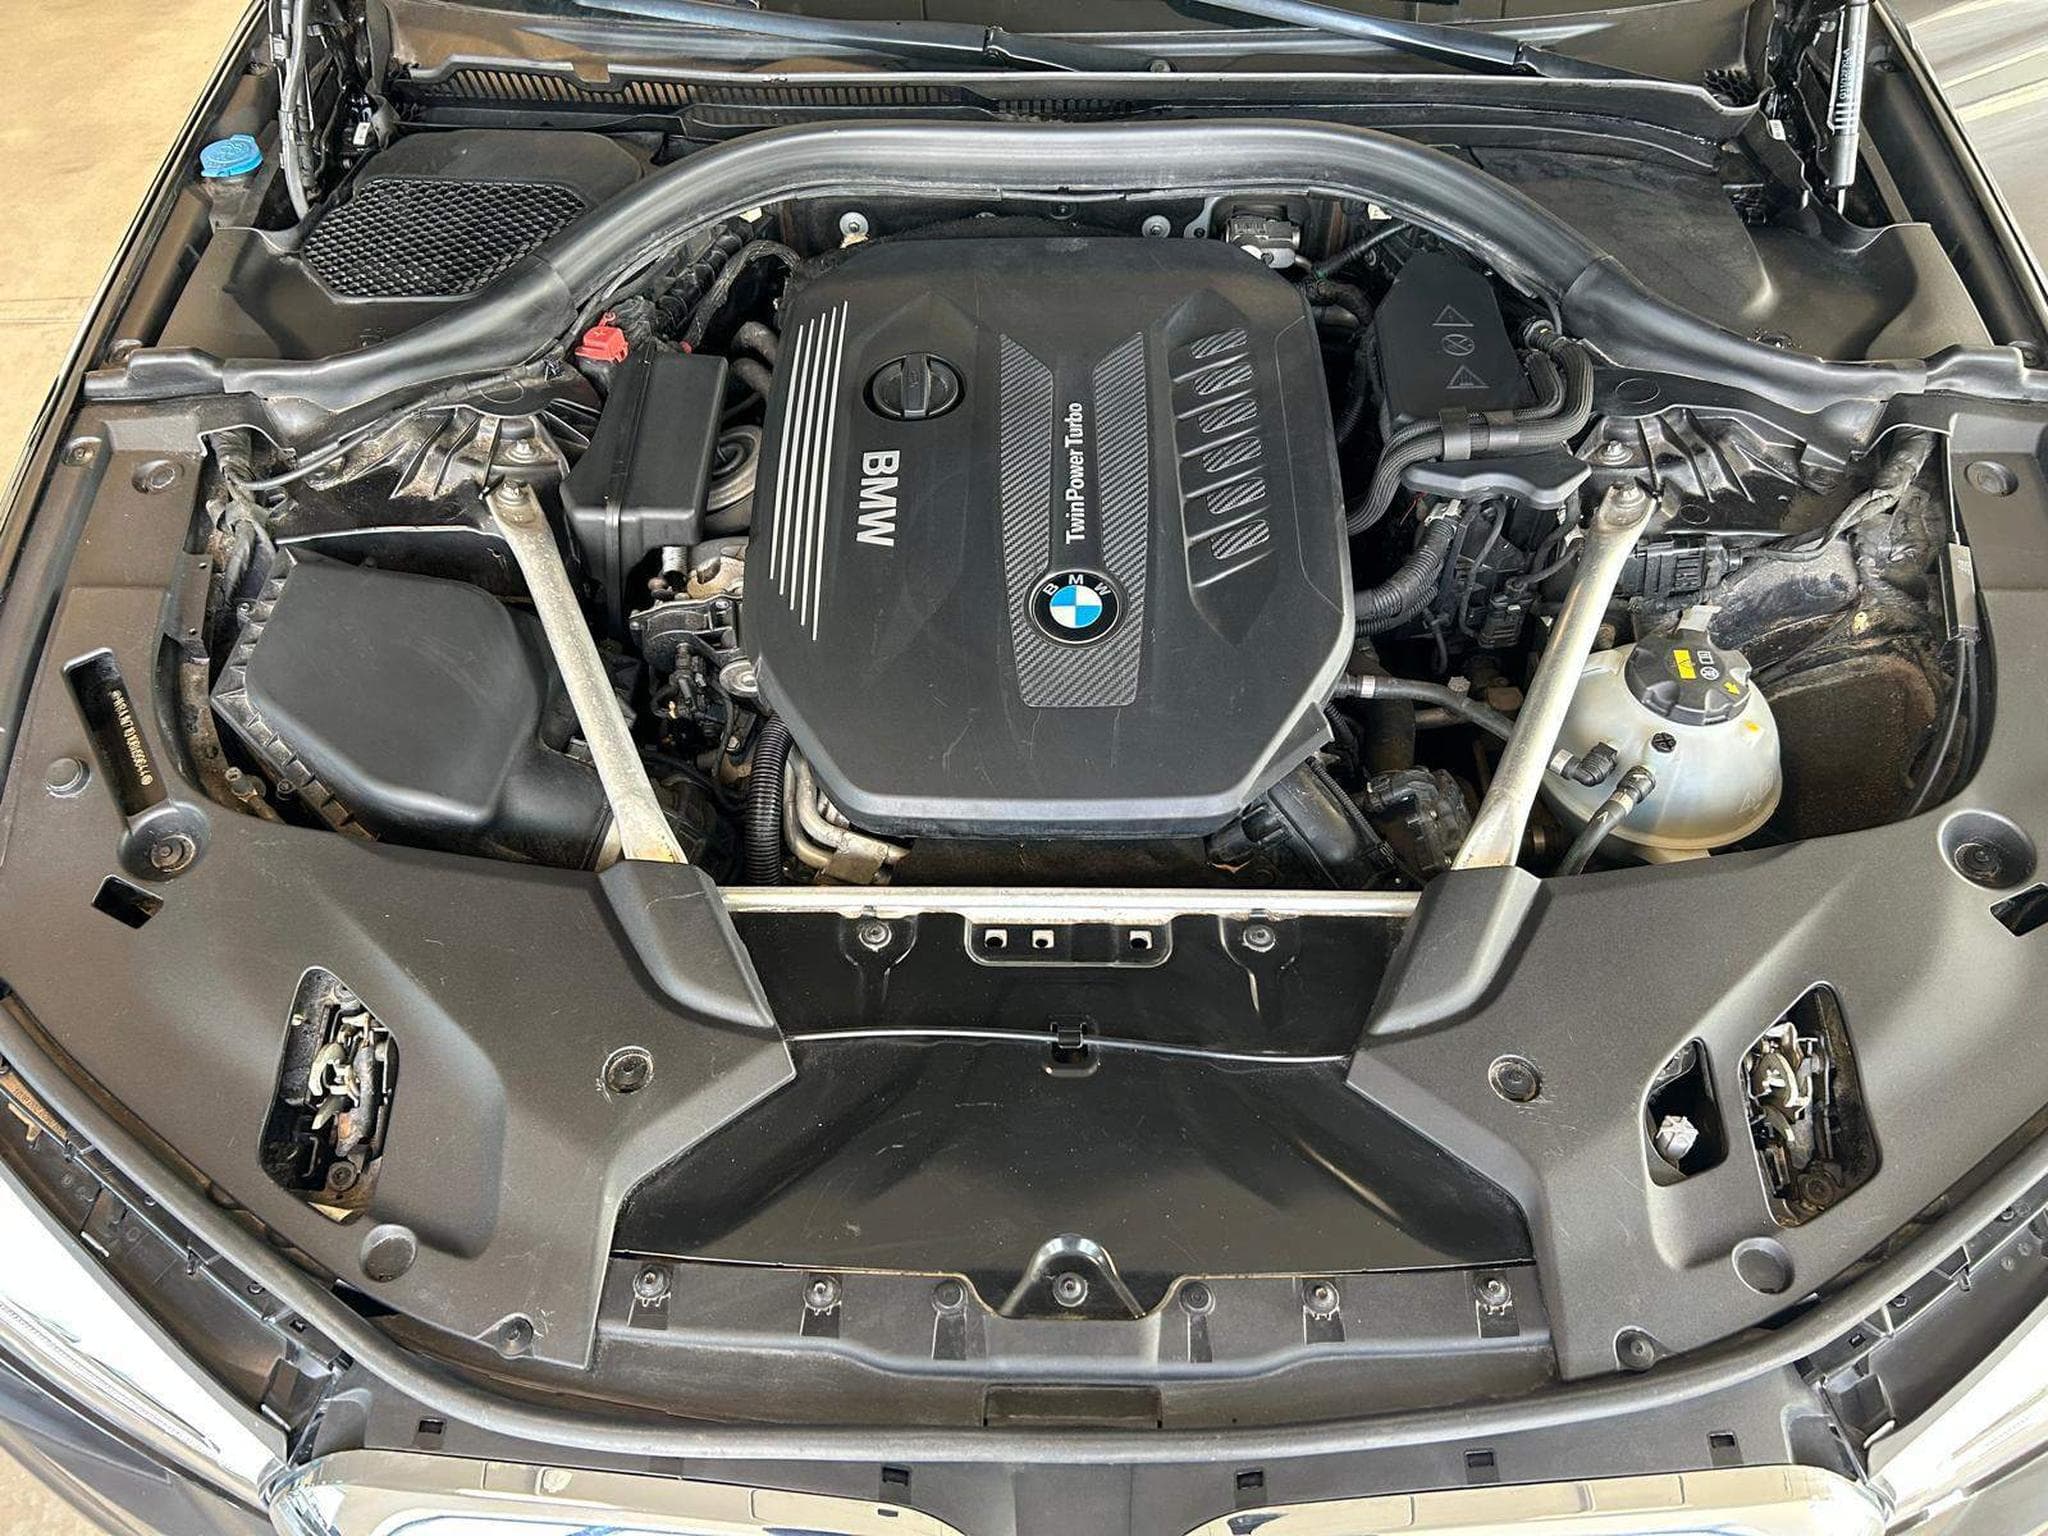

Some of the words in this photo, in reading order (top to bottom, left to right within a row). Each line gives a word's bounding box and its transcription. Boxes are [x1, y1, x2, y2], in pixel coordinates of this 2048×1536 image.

[1064, 402, 1084, 448] Turbo
[856, 450, 900, 546] BMW
[1064, 449, 1085, 544] TwinPower
[1042, 574, 1111, 596] BMW
